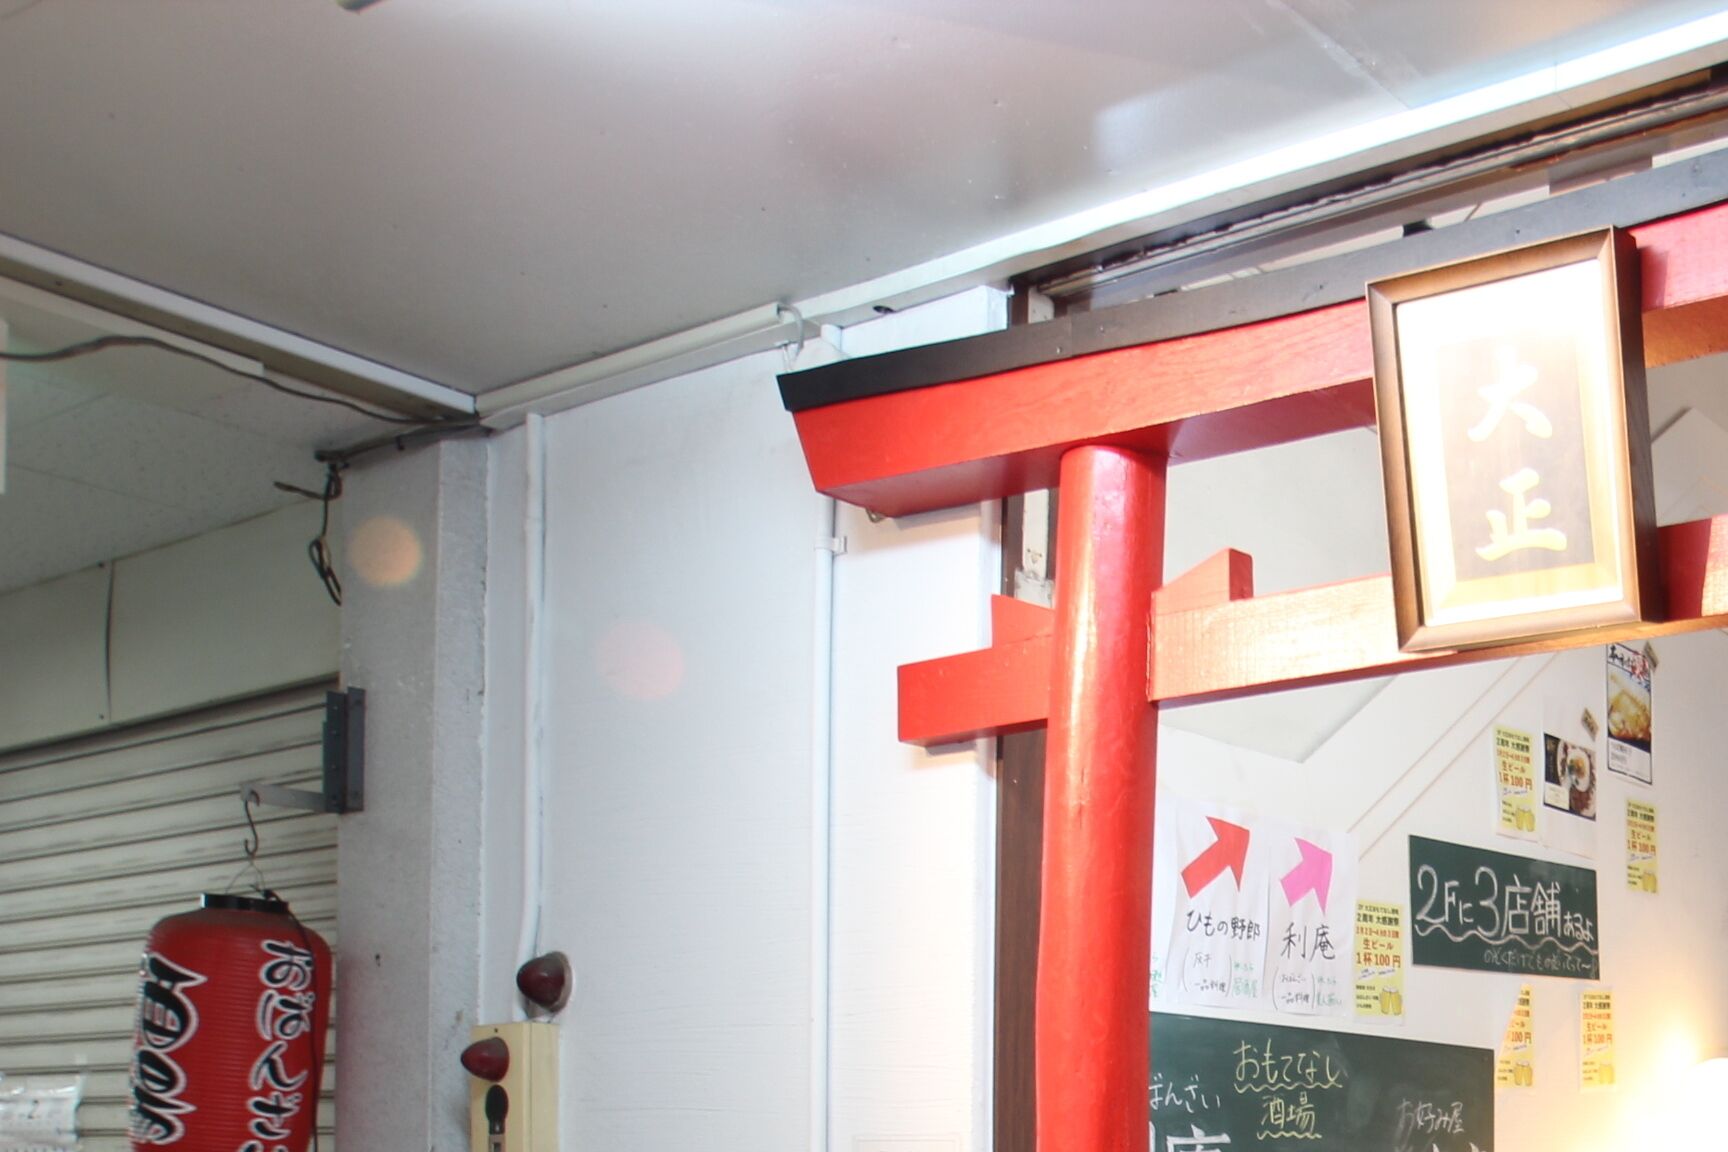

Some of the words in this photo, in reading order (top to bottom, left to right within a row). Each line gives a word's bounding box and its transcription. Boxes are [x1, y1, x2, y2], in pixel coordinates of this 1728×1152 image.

[1466, 342, 1568, 562] 大正
[1186, 910, 1260, 941] ひもの野郎
[1281, 922, 1335, 961] 利庵
[1233, 1038, 1341, 1083] おもてなし
[1261, 1091, 1315, 1134] 酒場
